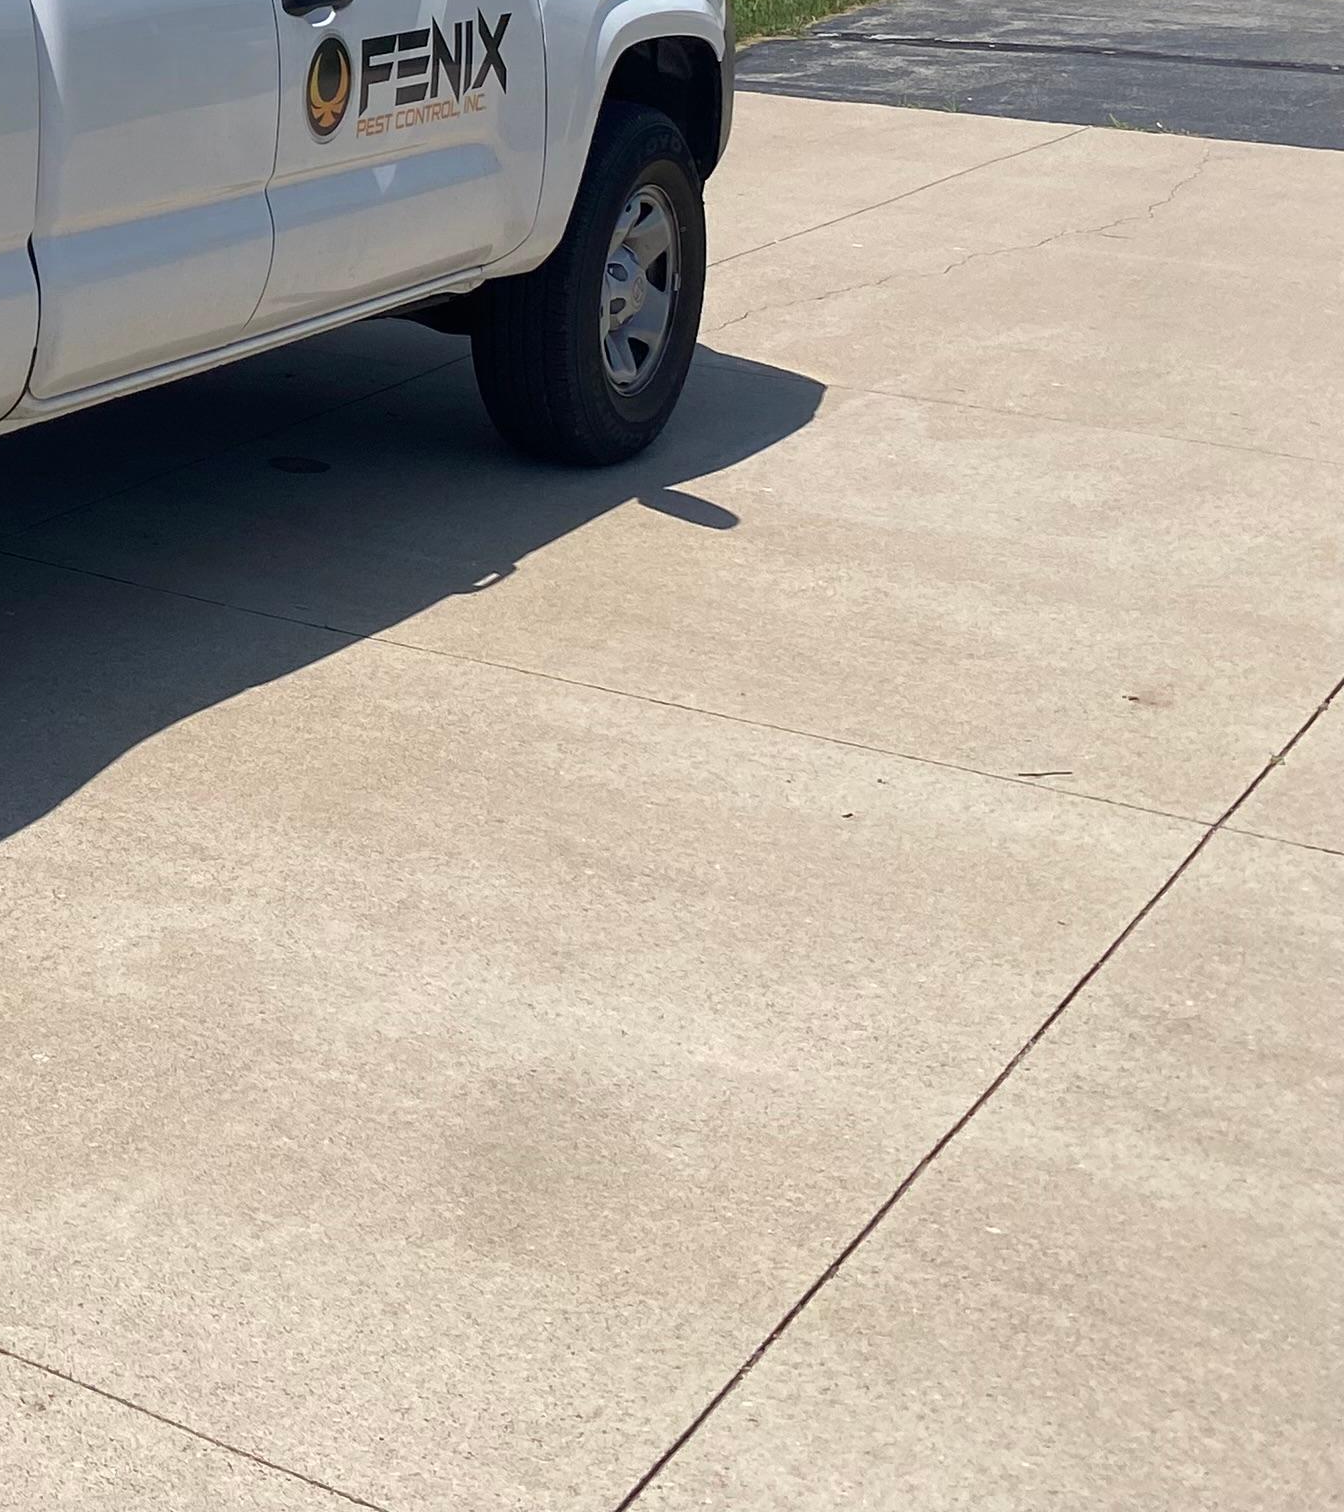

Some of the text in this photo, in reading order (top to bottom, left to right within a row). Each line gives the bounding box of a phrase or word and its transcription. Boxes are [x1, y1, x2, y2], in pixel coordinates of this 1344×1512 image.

[359, 7, 512, 117] FENIX
[356, 113, 393, 138] PEST
[395, 97, 461, 130] CONTROL,
